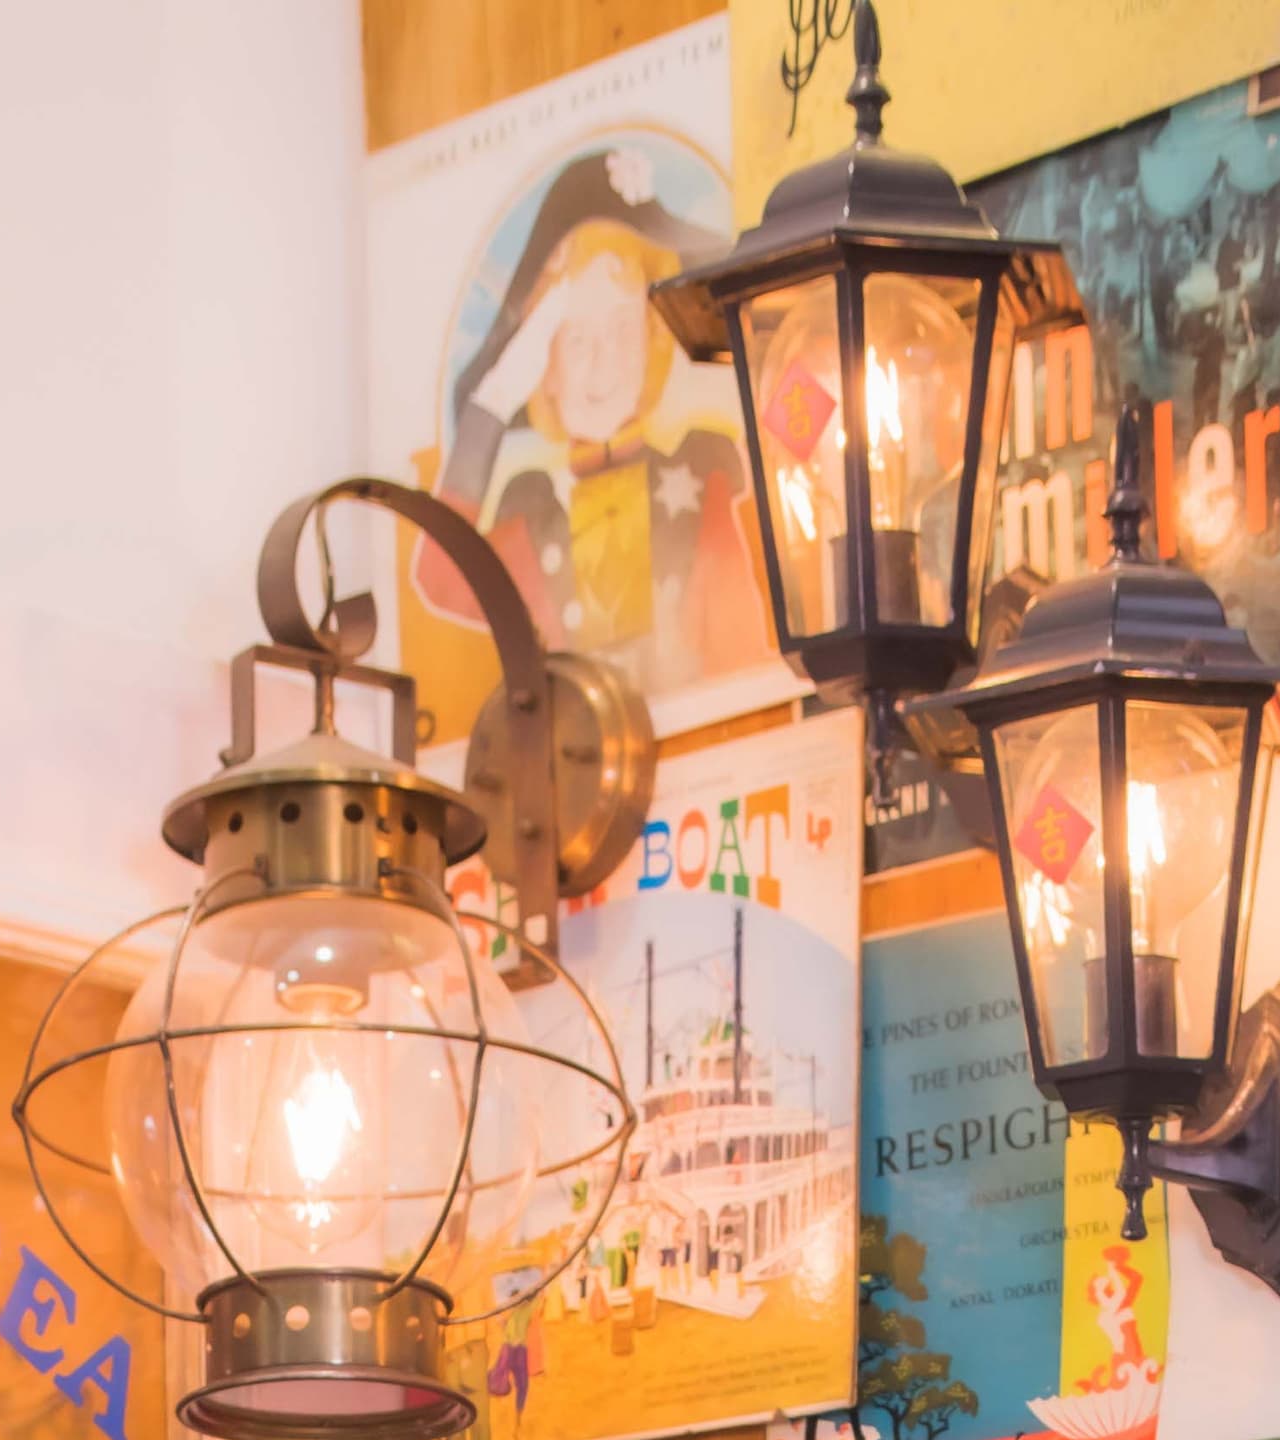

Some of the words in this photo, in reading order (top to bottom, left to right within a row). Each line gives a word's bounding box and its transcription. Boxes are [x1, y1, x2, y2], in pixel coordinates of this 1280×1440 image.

[637, 783, 791, 910] BOAT
[1032, 804, 1070, 864] 吉
[880, 1015, 939, 1046] PINES
[944, 1006, 971, 1031] OF
[908, 1071, 950, 1095] THE
[875, 1101, 1092, 1178] RESPIGH
